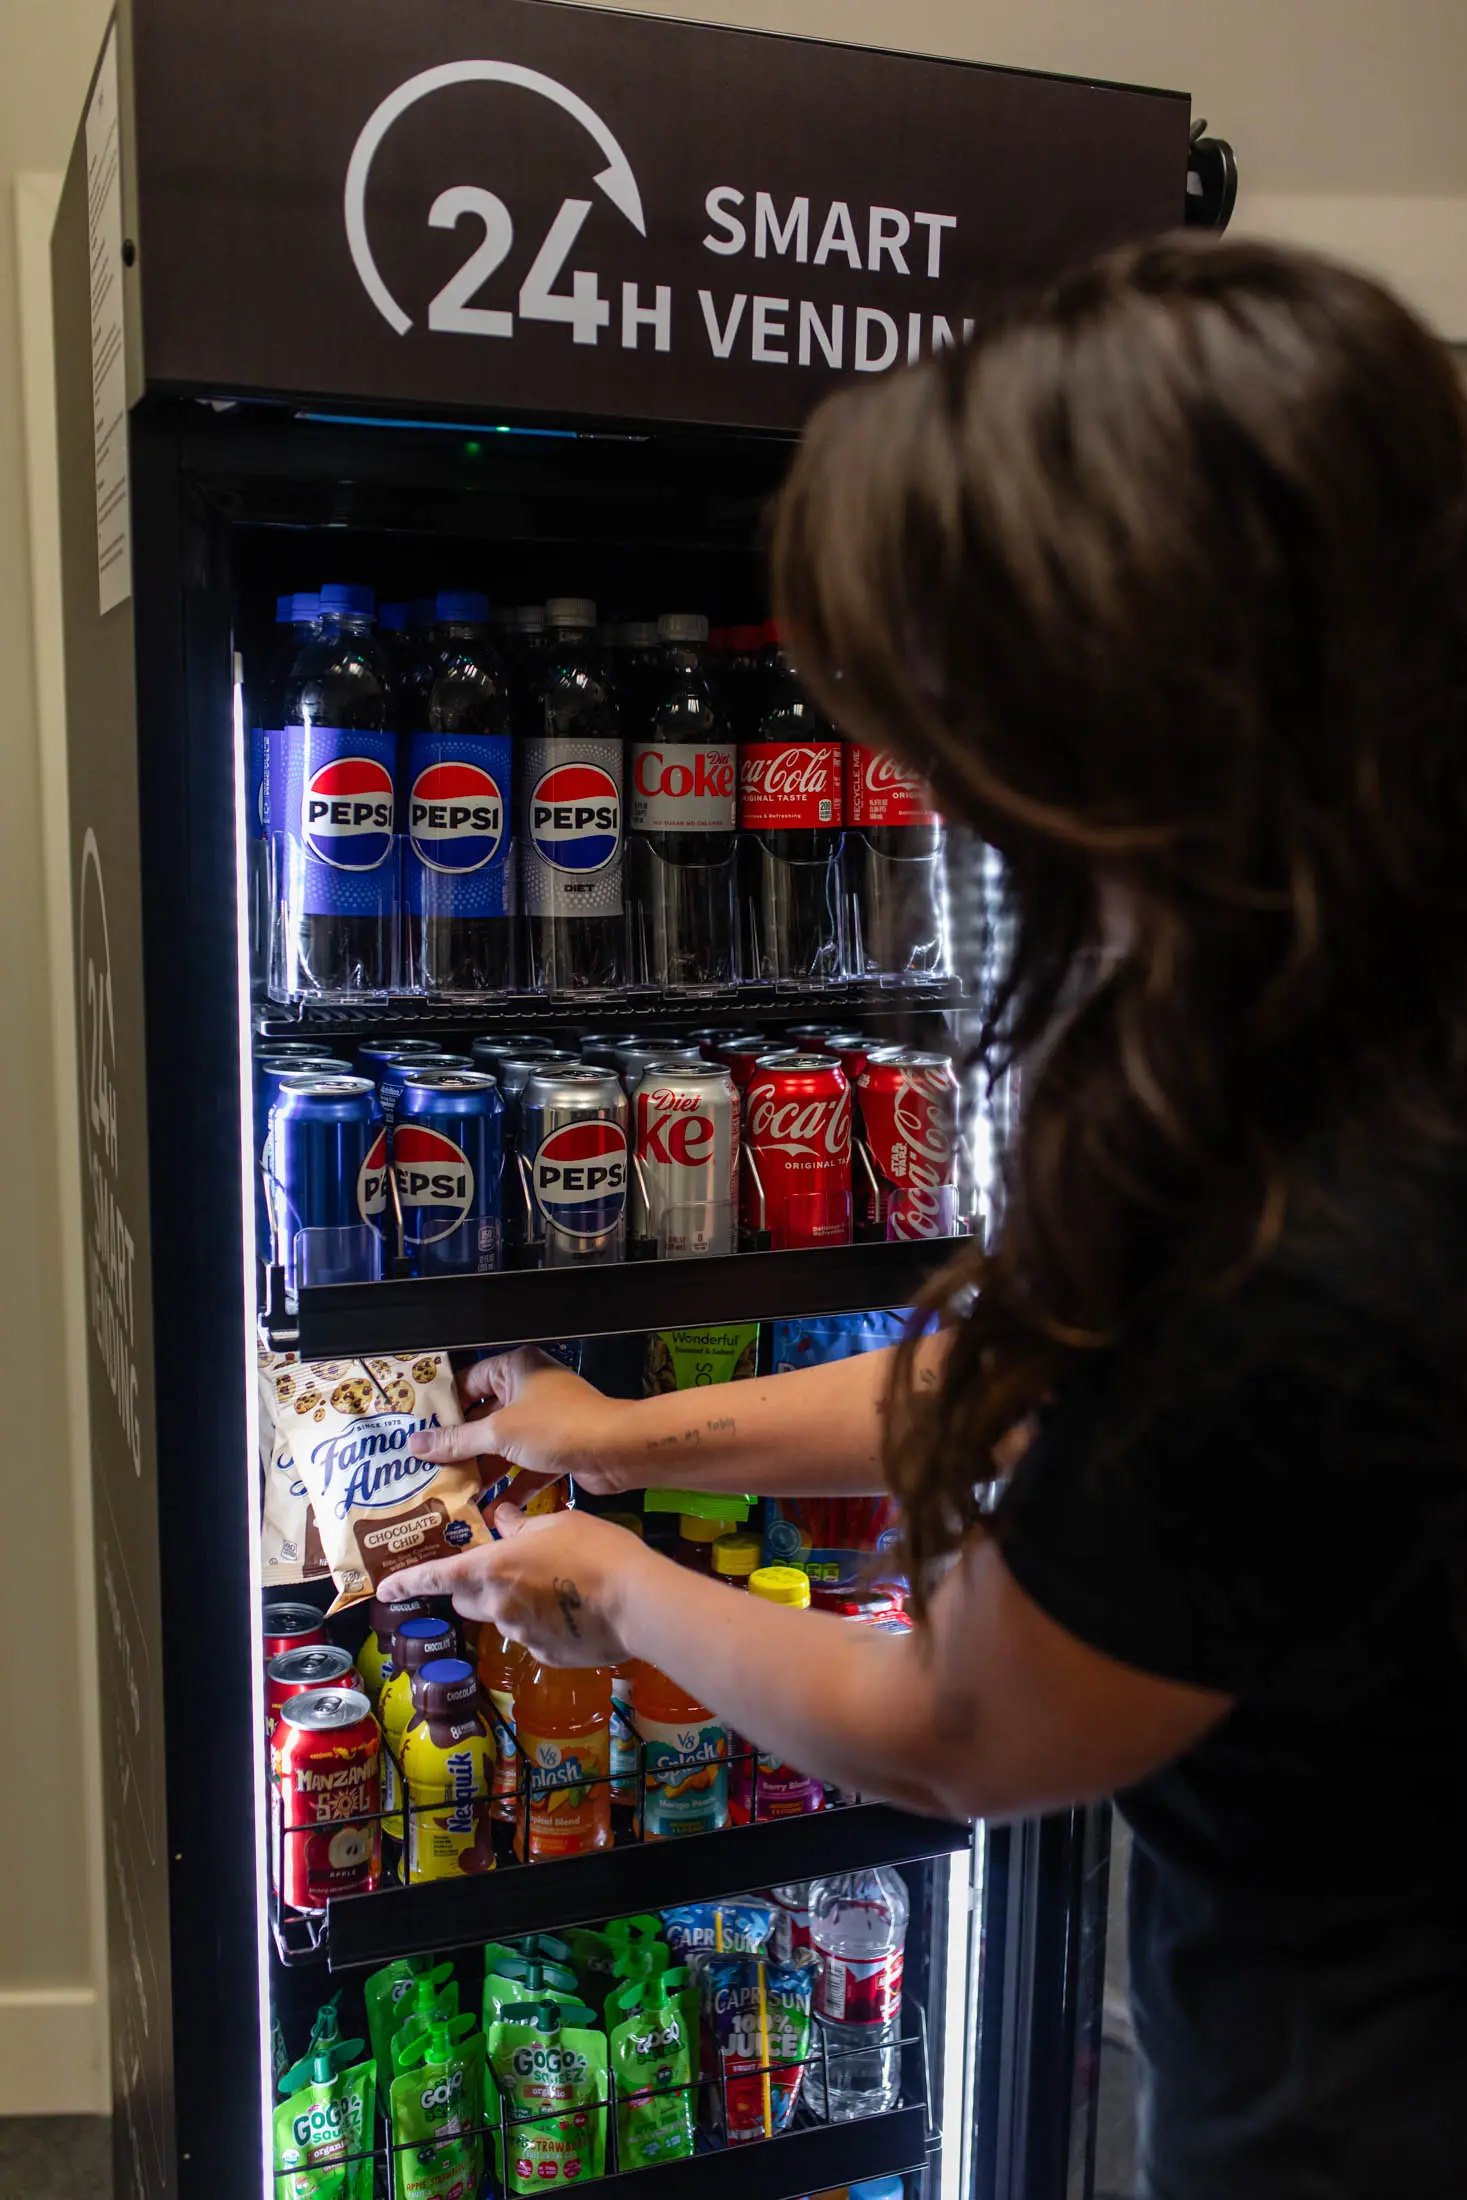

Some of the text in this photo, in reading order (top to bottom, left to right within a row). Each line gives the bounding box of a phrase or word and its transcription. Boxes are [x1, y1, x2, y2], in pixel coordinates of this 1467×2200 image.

[702, 186, 957, 278] SMART
[428, 185, 672, 352] 24H
[698, 289, 975, 373] VENDIN
[634, 750, 734, 797] Coke
[740, 748, 832, 793] ca-Cola
[853, 749, 861, 821] RECYCLE ME
[309, 800, 393, 828] PEPSI
[412, 804, 498, 830] PEPSI
[534, 806, 617, 830] PEPSI
[563, 883, 596, 893] DIET
[652, 1088, 702, 1112] Diet
[636, 1092, 715, 1167] ke
[747, 1084, 852, 1153] Coca-C
[539, 1163, 627, 1191] PEPSI
[784, 1160, 836, 1170] ORIGINAL
[397, 1170, 466, 1199] EPSI
[672, 1331, 738, 1346] Wonderful
[368, 1515, 438, 1545] CHOCOLATE
[392, 1534, 420, 1550] CHIP
[390, 1601, 421, 1612] CHOCOLATE
[447, 1683, 478, 1701] CHOCOLATE
[677, 1730, 695, 1749] V8
[540, 1747, 558, 1765] V8
[447, 1751, 479, 1834] Nequik
[762, 1781, 788, 1792] Berry
[554, 1816, 580, 1825] Blend
[329, 1869, 356, 1879] APPLE
[667, 1925, 716, 1950] CAPR
[714, 1986, 761, 2014] CAPR
[732, 2014, 793, 2034] 100%
[722, 2032, 798, 2058] JUICE
[313, 2141, 345, 2158] organi
